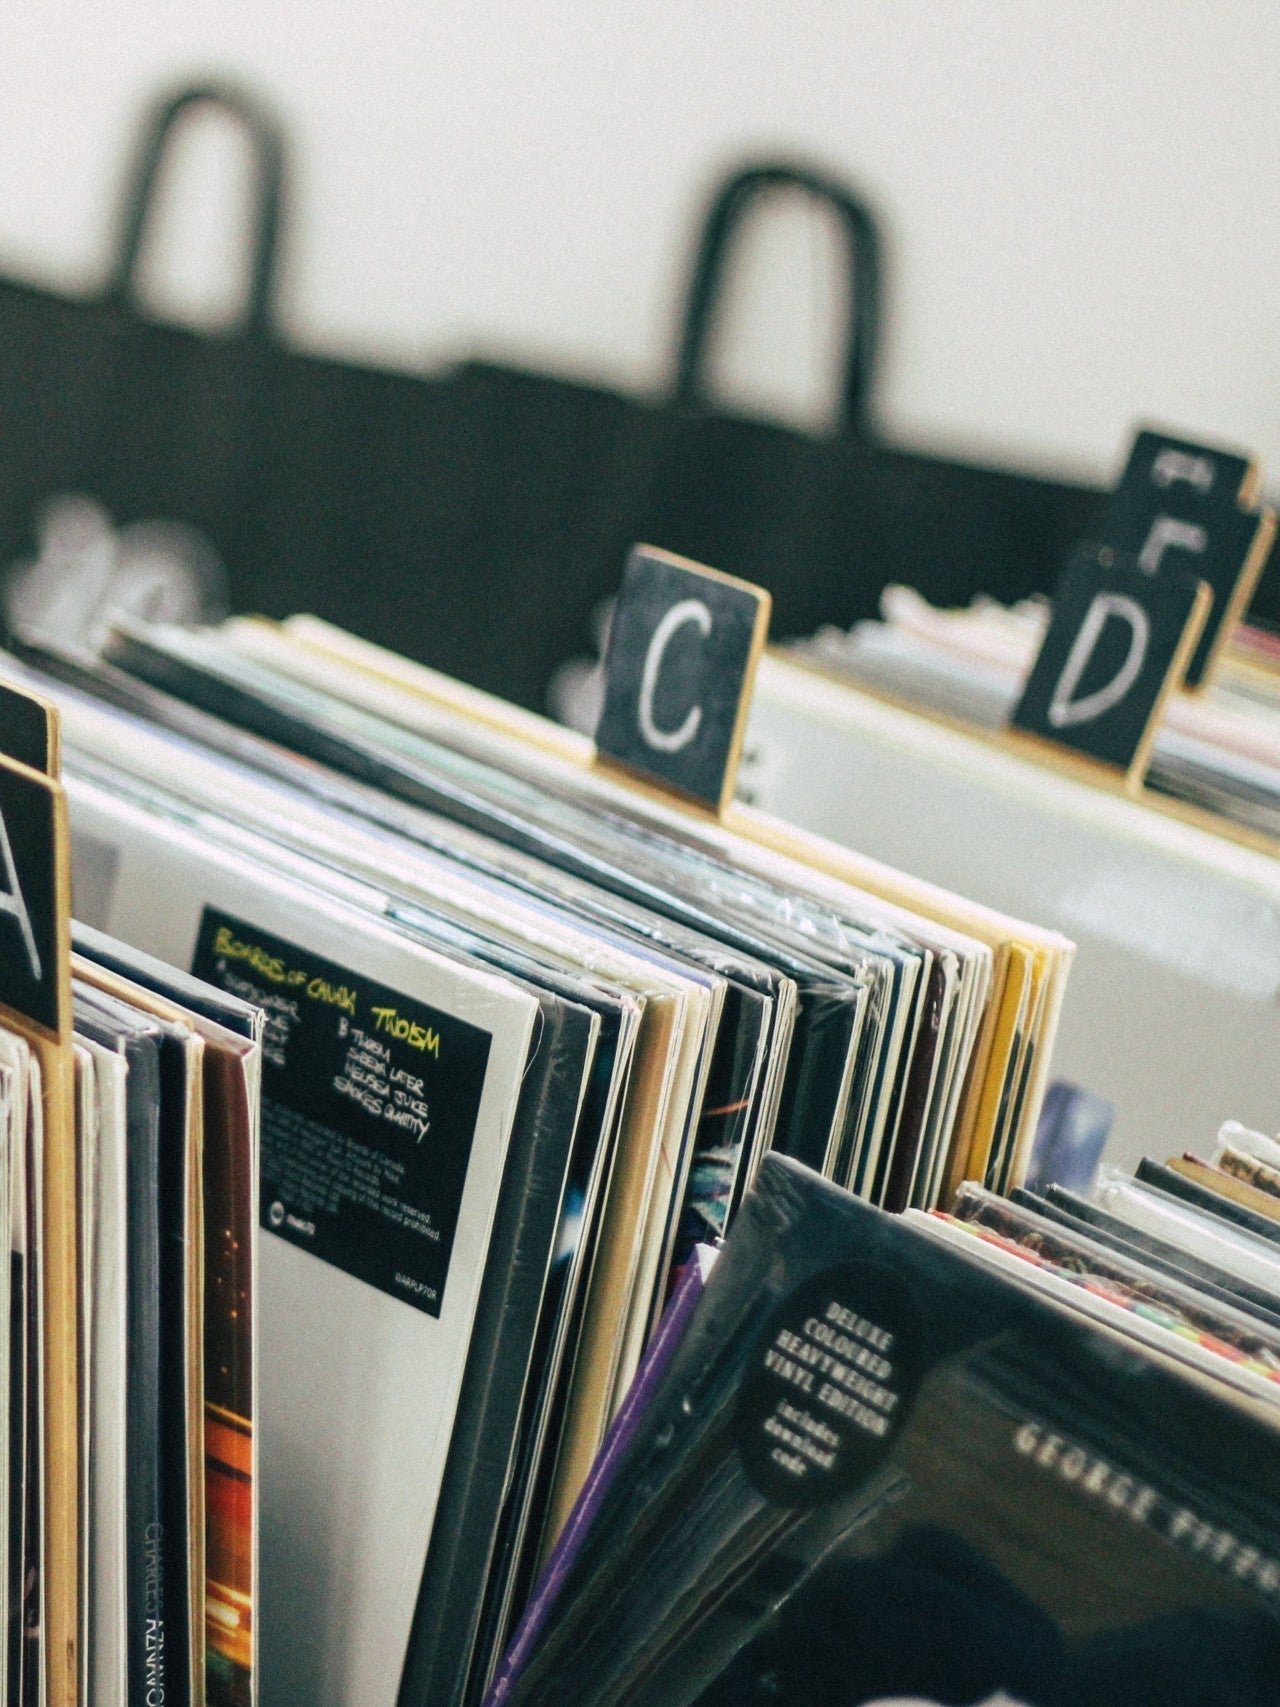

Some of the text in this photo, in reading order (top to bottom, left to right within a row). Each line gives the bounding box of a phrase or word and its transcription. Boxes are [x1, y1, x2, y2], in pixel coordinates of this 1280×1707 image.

[639, 599, 713, 755] C
[1048, 591, 1151, 728] D
[371, 1006, 441, 1060] TWOISM
[389, 1067, 424, 1097] LATER
[394, 1090, 428, 1118] JUICE
[803, 1317, 892, 1379] COLOURED
[826, 1301, 893, 1351] DELUXE
[765, 1349, 815, 1393] VINYL
[1013, 1422, 1156, 1521] GEORGE
[145, 1618, 165, 1707] AZNAVO
